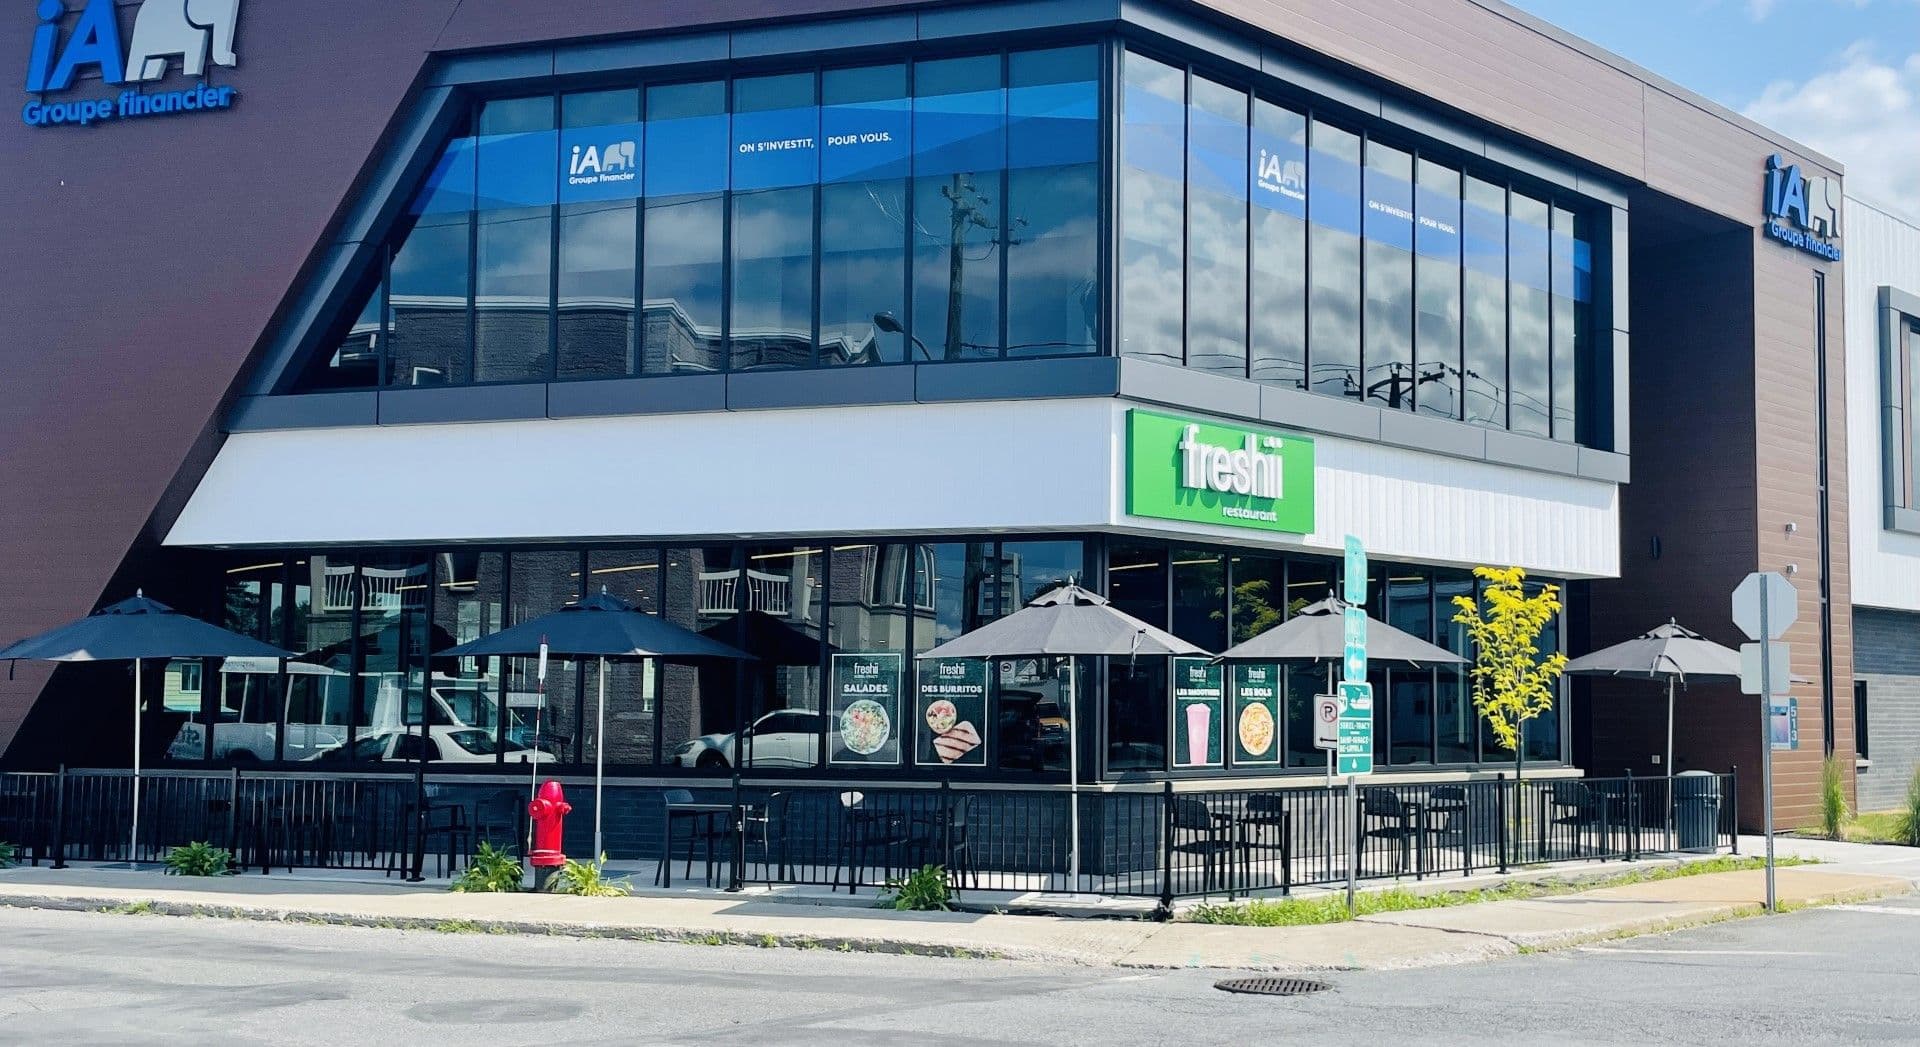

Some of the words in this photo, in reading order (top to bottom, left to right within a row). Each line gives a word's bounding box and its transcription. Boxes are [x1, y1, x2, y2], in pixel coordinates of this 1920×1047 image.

[23, 98, 113, 126] Groupe
[118, 82, 236, 117] financier
[739, 143, 756, 153] ON
[757, 138, 815, 152] S'INVESTIT,
[828, 135, 857, 146] POUR
[860, 132, 892, 144] VOUS.
[569, 175, 599, 186] Groupe
[599, 172, 635, 183] financier
[1368, 200, 1379, 210] ON
[1419, 216, 1437, 229] POUR
[1771, 221, 1804, 248] Groupe
[1179, 423, 1284, 500] freshii
[1222, 506, 1277, 522] restaurant
[853, 662, 879, 675] freshii
[939, 662, 966, 675] freshii
[843, 683, 889, 693] SALADES
[921, 685, 938, 693] DES
[939, 685, 983, 693] BURRITOS
[1176, 688, 1187, 696] LES
[1240, 687, 1254, 697] LES
[1254, 687, 1272, 697] BOLS
